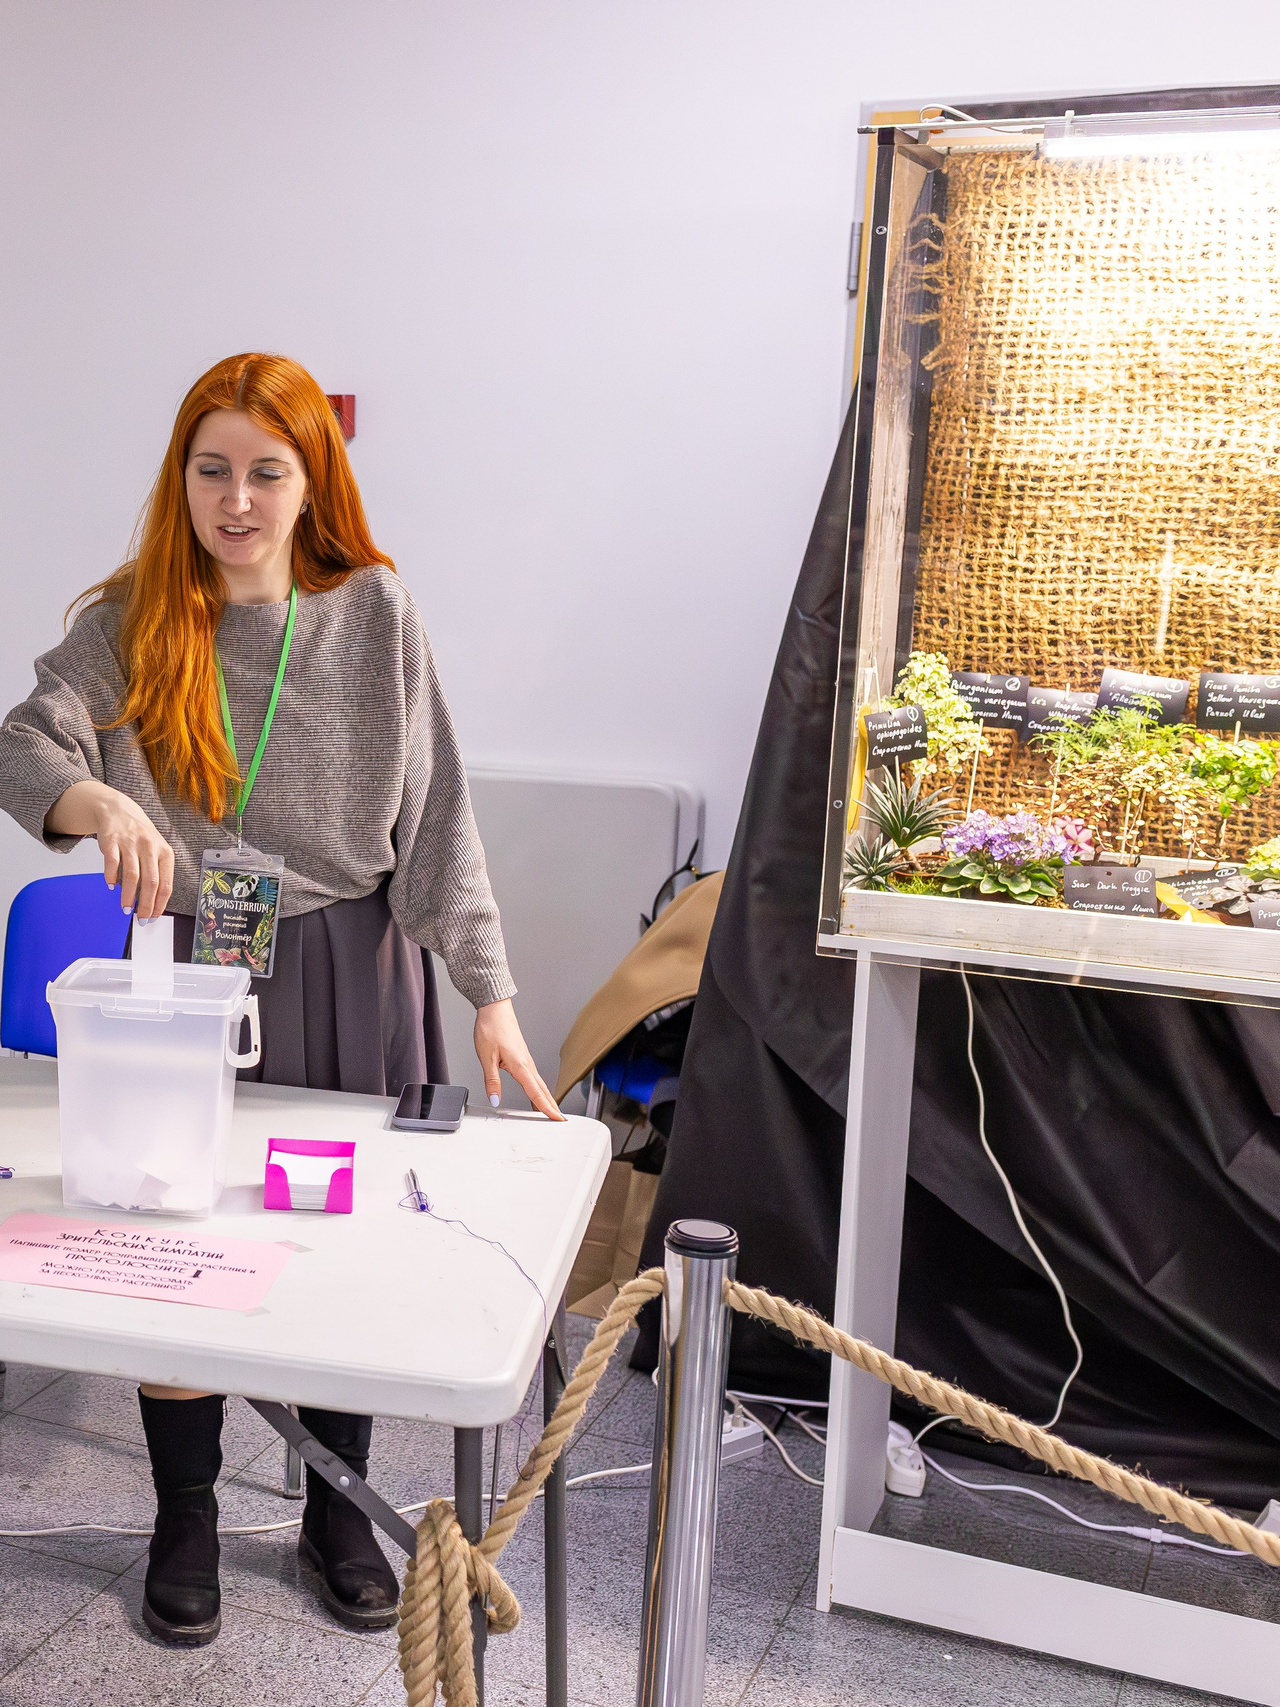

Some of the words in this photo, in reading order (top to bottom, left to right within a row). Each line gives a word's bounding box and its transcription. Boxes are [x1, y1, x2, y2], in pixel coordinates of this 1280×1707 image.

[950, 680, 1003, 696] Pelargonium
[1204, 680, 1228, 691] Ficus
[1097, 881, 1117, 890] Dark
[56, 1233, 148, 1250] ЗРИТЕЛЬСКИХ
[151, 1246, 224, 1260] СИМПАТИЙ
[63, 1247, 101, 1255] НОМЕР
[200, 1263, 247, 1274] РАСТЕНИЯ
